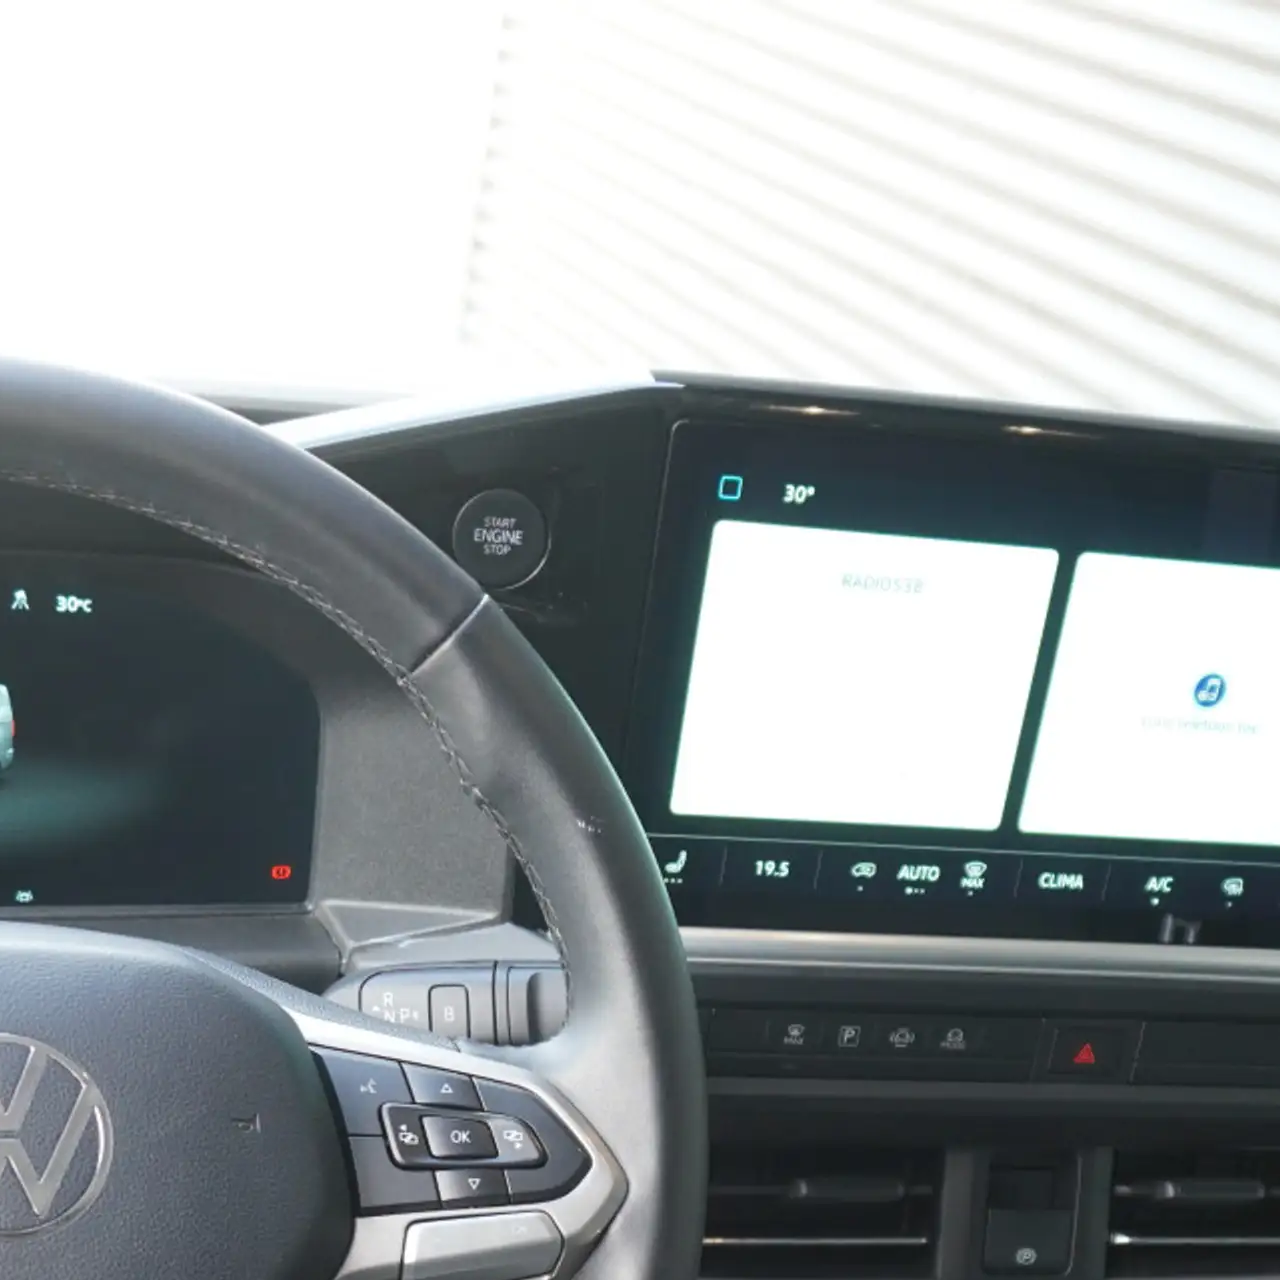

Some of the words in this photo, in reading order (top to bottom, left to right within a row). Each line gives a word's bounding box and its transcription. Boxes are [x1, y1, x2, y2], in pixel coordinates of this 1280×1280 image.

[783, 484, 815, 503] 30°
[484, 516, 517, 529] START
[474, 528, 523, 545] ENGINE
[483, 543, 511, 555] STOP
[755, 861, 790, 877] 19.5
[897, 864, 941, 882] AUTO
[960, 877, 985, 888] MAX
[1038, 873, 1083, 890] CLIMA
[1145, 876, 1174, 893] A/C
[450, 1130, 471, 1143] OK
